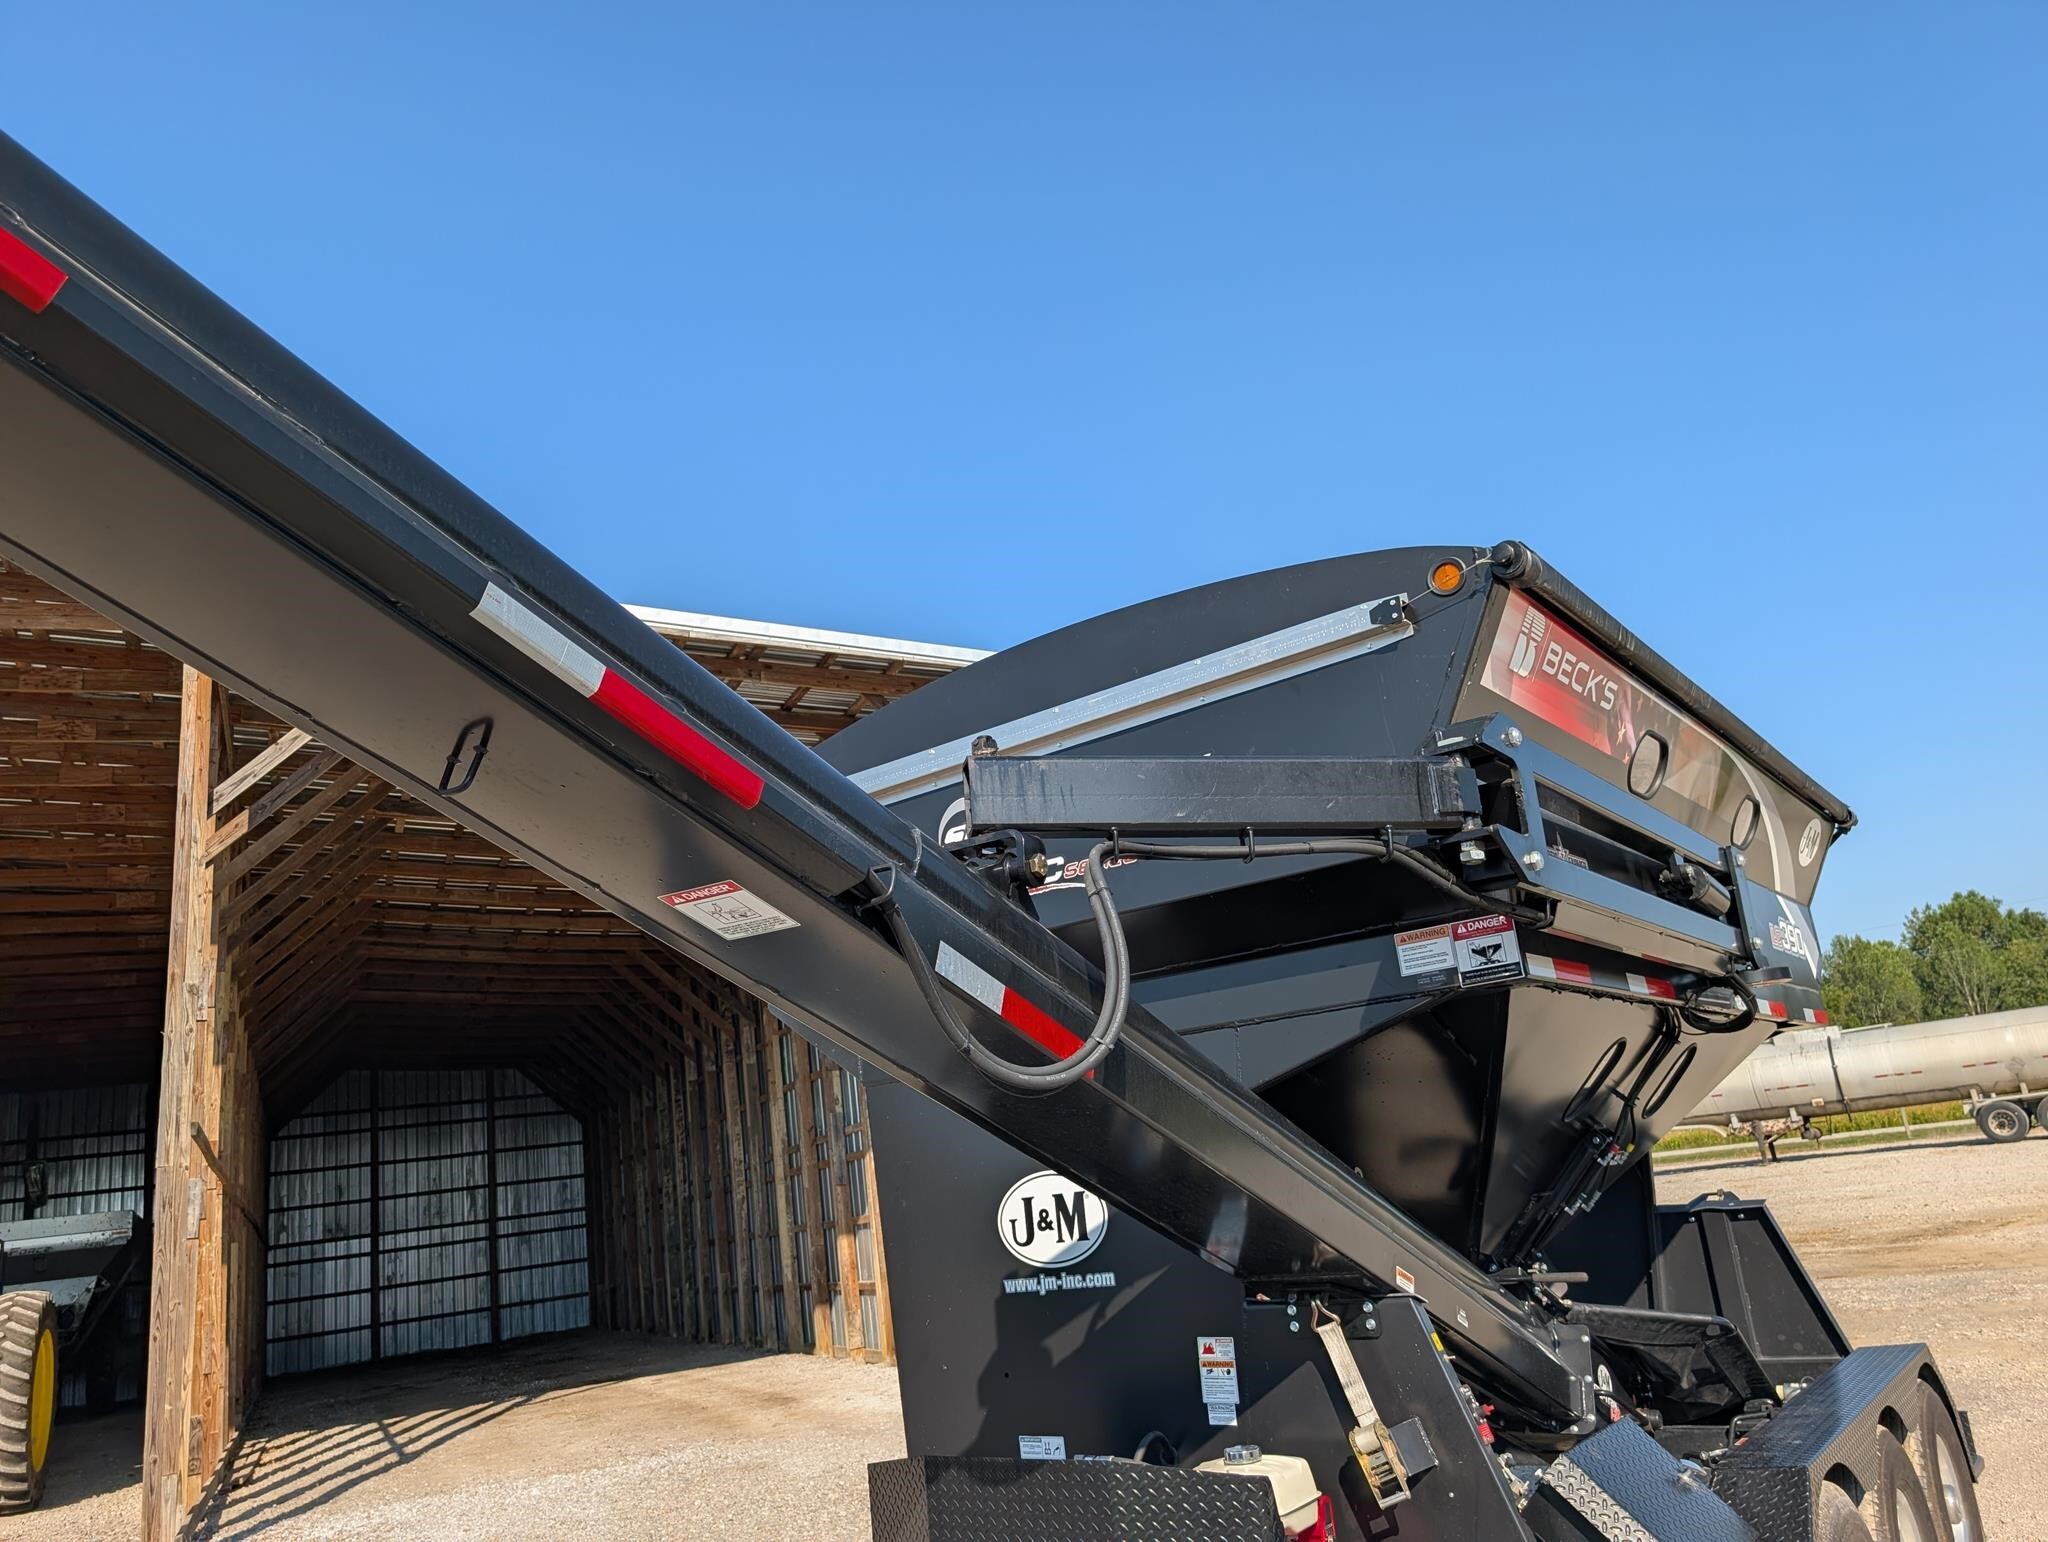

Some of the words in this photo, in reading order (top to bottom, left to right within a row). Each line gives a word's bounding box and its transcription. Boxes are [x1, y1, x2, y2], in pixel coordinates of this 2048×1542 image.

[1542, 641, 1618, 711] BECK'S
[682, 884, 733, 900] DANGER
[1467, 916, 1507, 931] DANGER
[1406, 928, 1446, 941] WARNING
[1009, 1191, 1090, 1247] J&M
[1003, 1272, 1116, 1296] www.jm-inc.com
